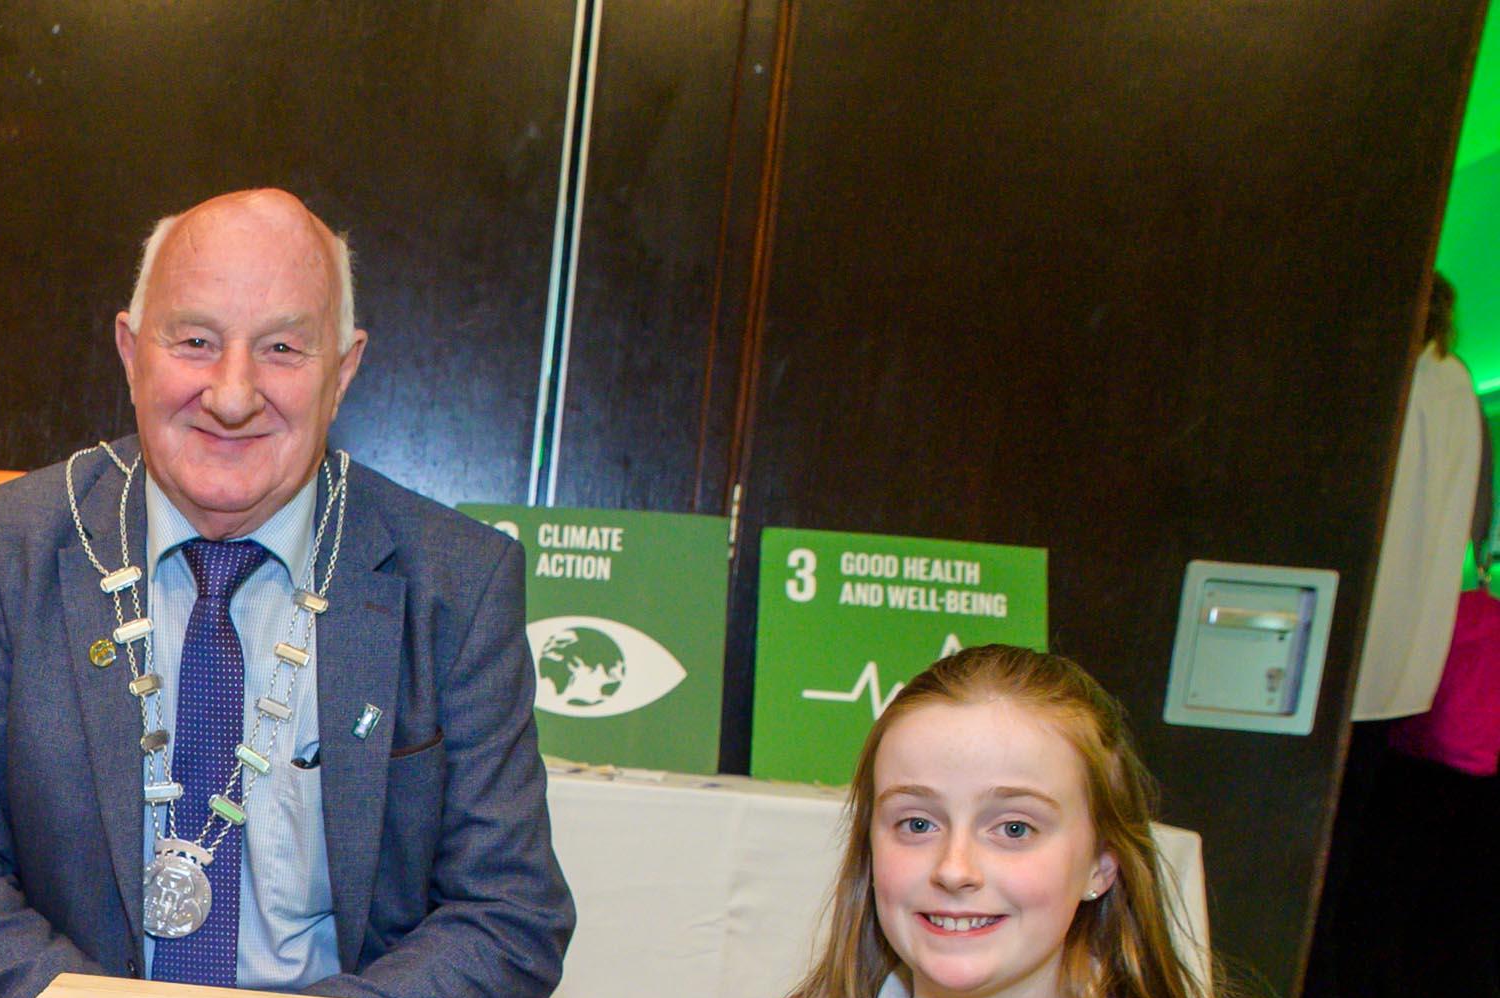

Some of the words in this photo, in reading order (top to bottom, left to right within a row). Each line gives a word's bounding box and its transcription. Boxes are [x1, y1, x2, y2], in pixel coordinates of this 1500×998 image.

[537, 522, 624, 552] CLIMATE
[535, 552, 612, 581] ACTION
[785, 547, 817, 602] 3
[839, 551, 899, 579] GOOD
[902, 556, 982, 586] HEALTH
[838, 581, 884, 607] AND
[887, 584, 1008, 618] WELL-BEING
